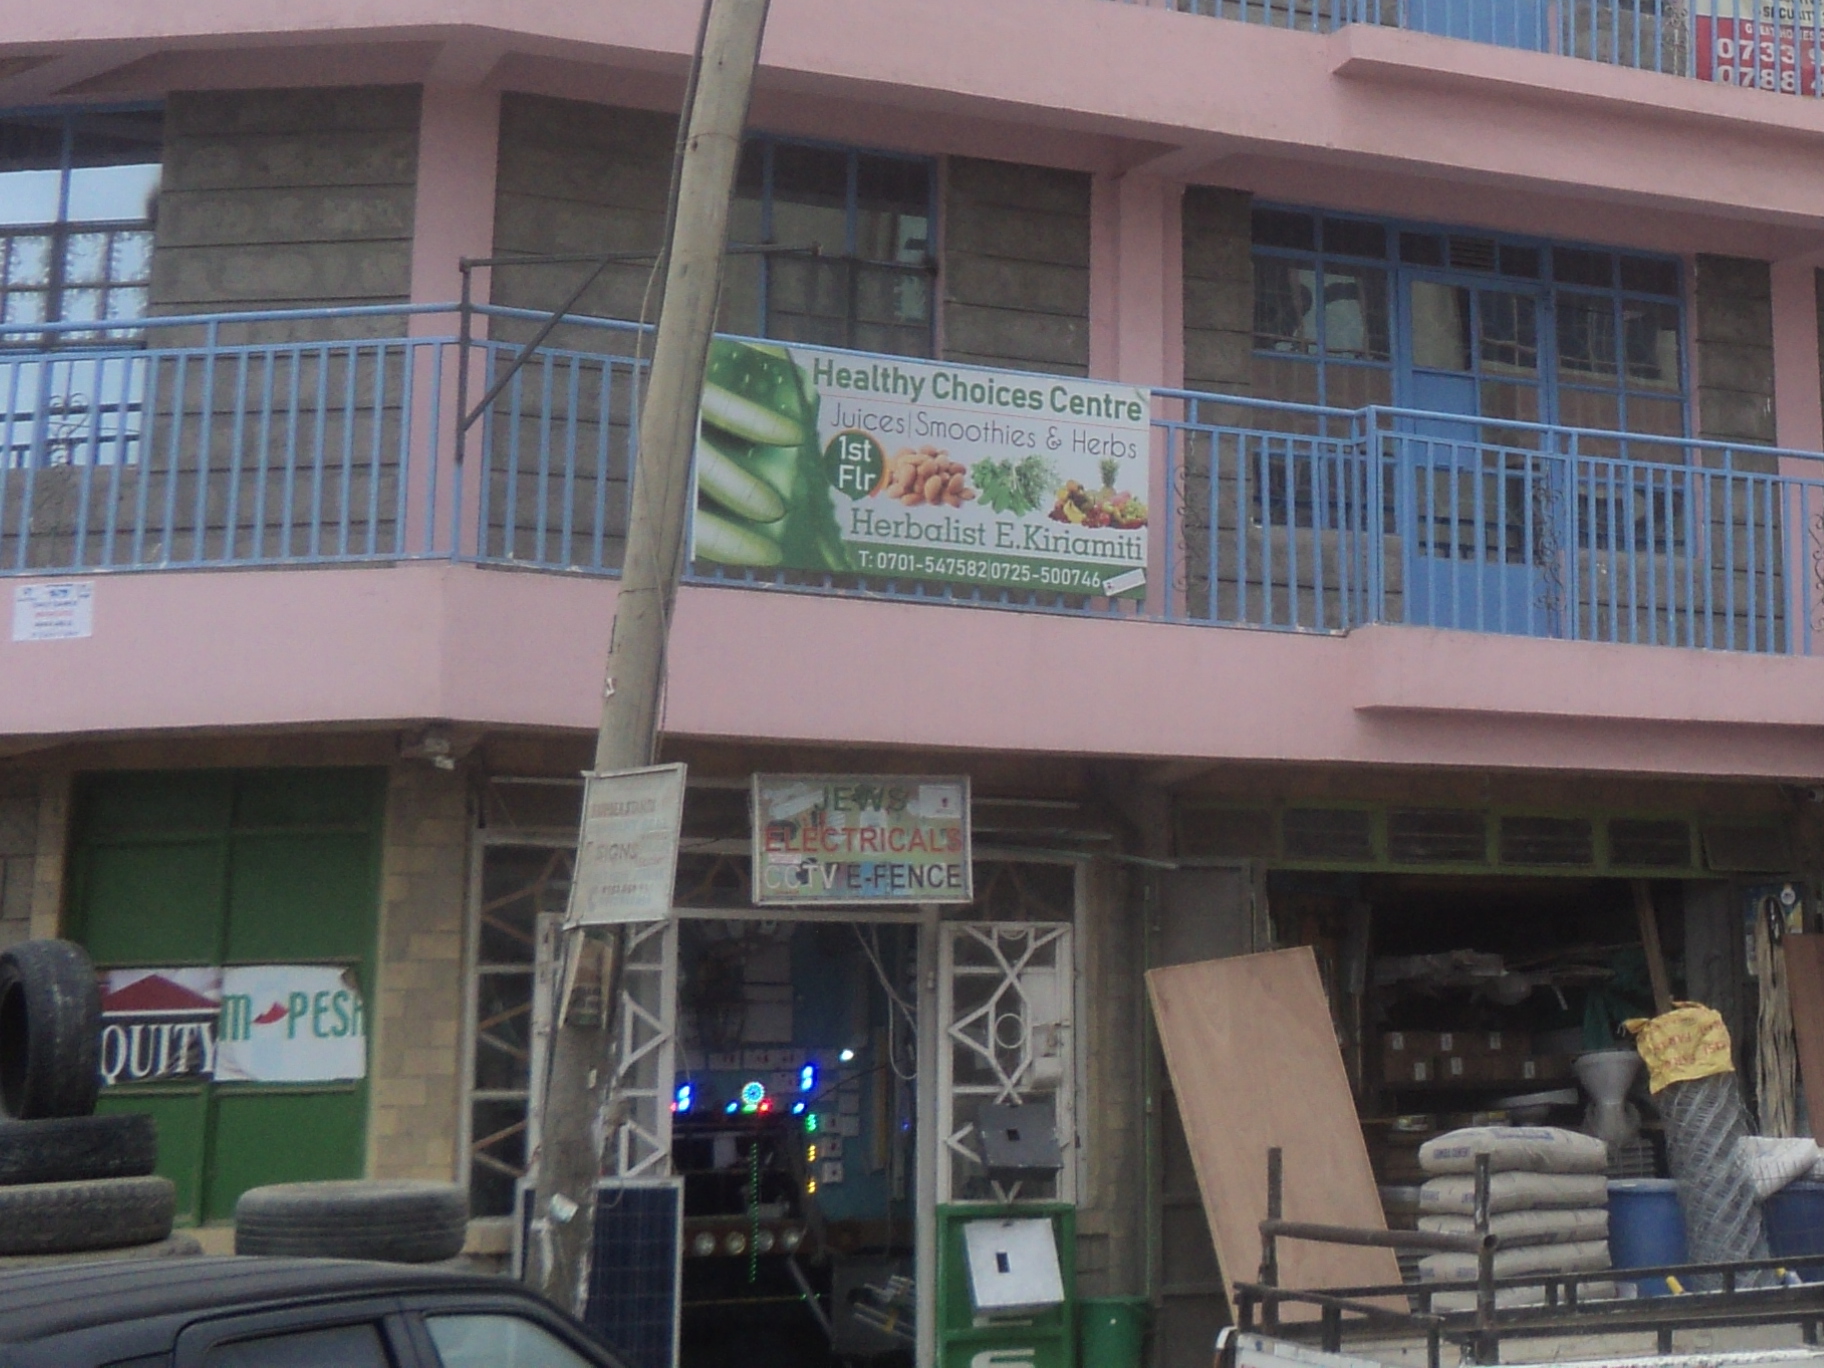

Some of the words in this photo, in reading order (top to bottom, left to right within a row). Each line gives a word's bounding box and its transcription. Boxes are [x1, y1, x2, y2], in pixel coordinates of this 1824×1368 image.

[812, 357, 925, 403] Healthy
[932, 371, 1043, 413] Choices
[1050, 386, 1143, 422] Centre
[829, 402, 905, 435] Juices
[915, 411, 1037, 450] Smoothies
[1045, 429, 1063, 451] &
[1072, 431, 1138, 460] Herbs
[838, 436, 872, 463] 1st
[838, 464, 877, 491] Flr
[850, 508, 988, 549] Herbalist
[764, 826, 964, 854] ELECTRICALS
[764, 862, 838, 890] CCTV
[846, 862, 962, 889] E-FENCE
[101, 1022, 216, 1085] QUITY
